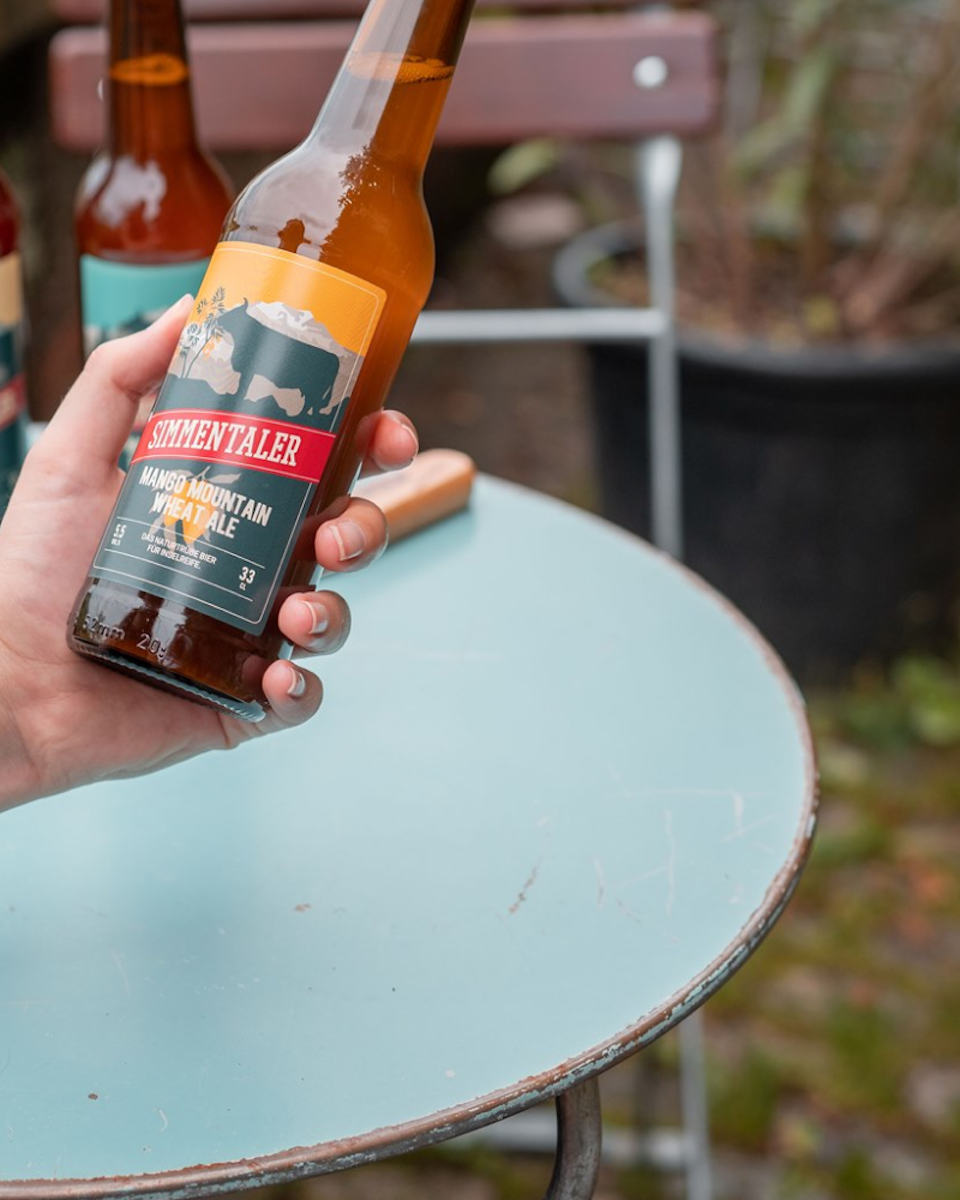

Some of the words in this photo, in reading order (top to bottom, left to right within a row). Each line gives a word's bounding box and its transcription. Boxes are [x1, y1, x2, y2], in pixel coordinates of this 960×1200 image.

[148, 418, 302, 467] SIMMENTALER
[138, 465, 187, 494] MANGO
[187, 479, 273, 527] MOUNTAIN
[150, 491, 206, 526] WHEAT
[205, 509, 240, 539] ALE
[141, 532, 155, 543] DAS
[199, 551, 217, 565] BIER
[146, 543, 161, 555] FÜR
[238, 566, 256, 584] 33
